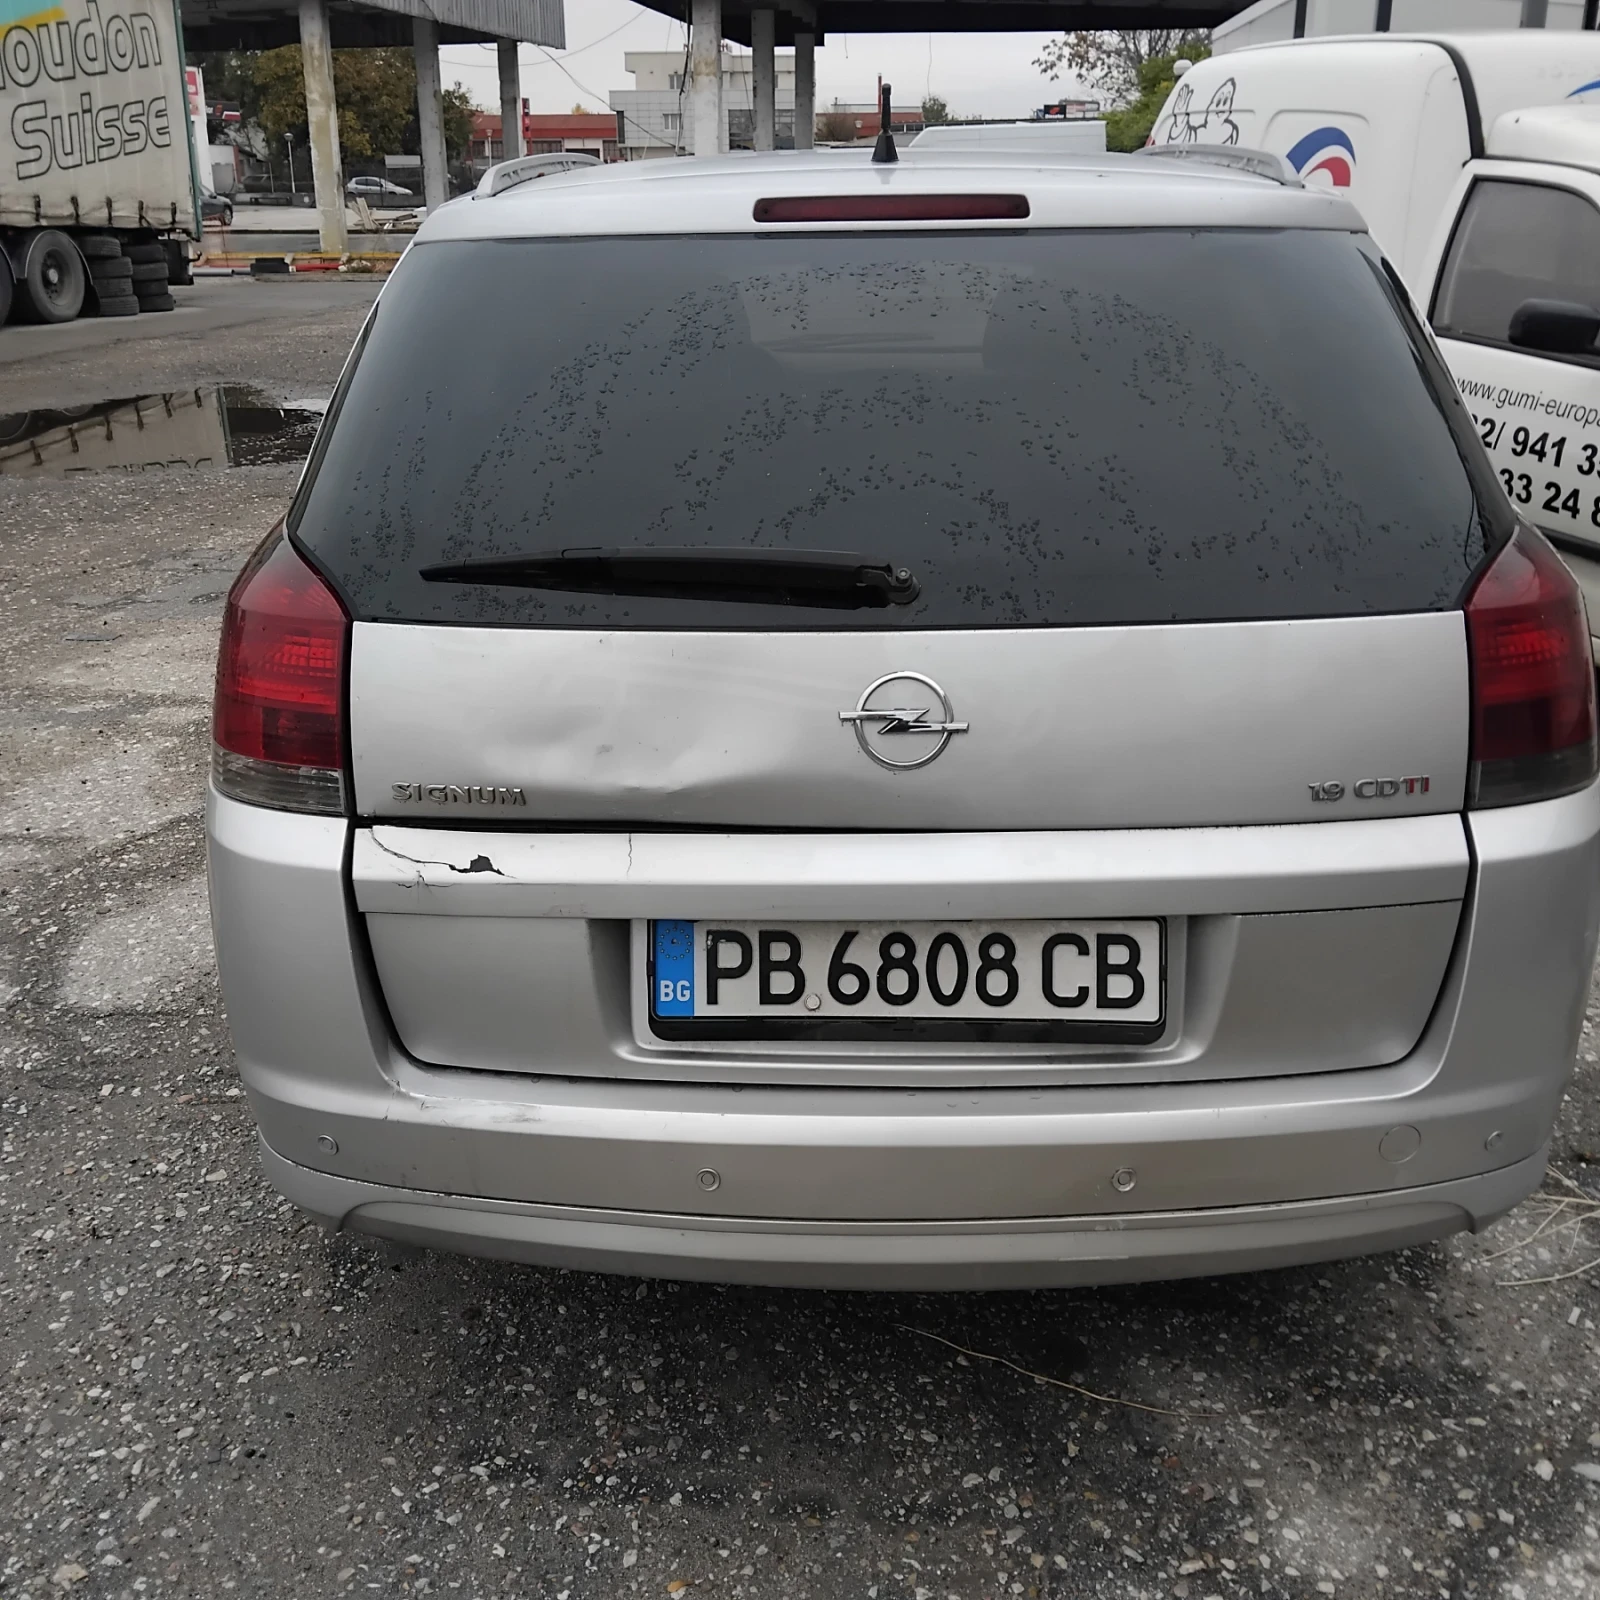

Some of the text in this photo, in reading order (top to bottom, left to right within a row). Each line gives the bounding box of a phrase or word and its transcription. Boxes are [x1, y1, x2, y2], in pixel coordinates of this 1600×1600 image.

[0, 0, 162, 90] oudon
[11, 92, 172, 181] Suisse
[1457, 378, 1600, 429] www.gumi-europ
[1471, 413, 1600, 479] 2/ 941 3
[1542, 481, 1580, 520] 24
[391, 781, 527, 807] SIGNUM
[1353, 774, 1430, 799] CDTI
[660, 980, 691, 1002] BG
[706, 929, 1146, 1009] PB 6808 CB
